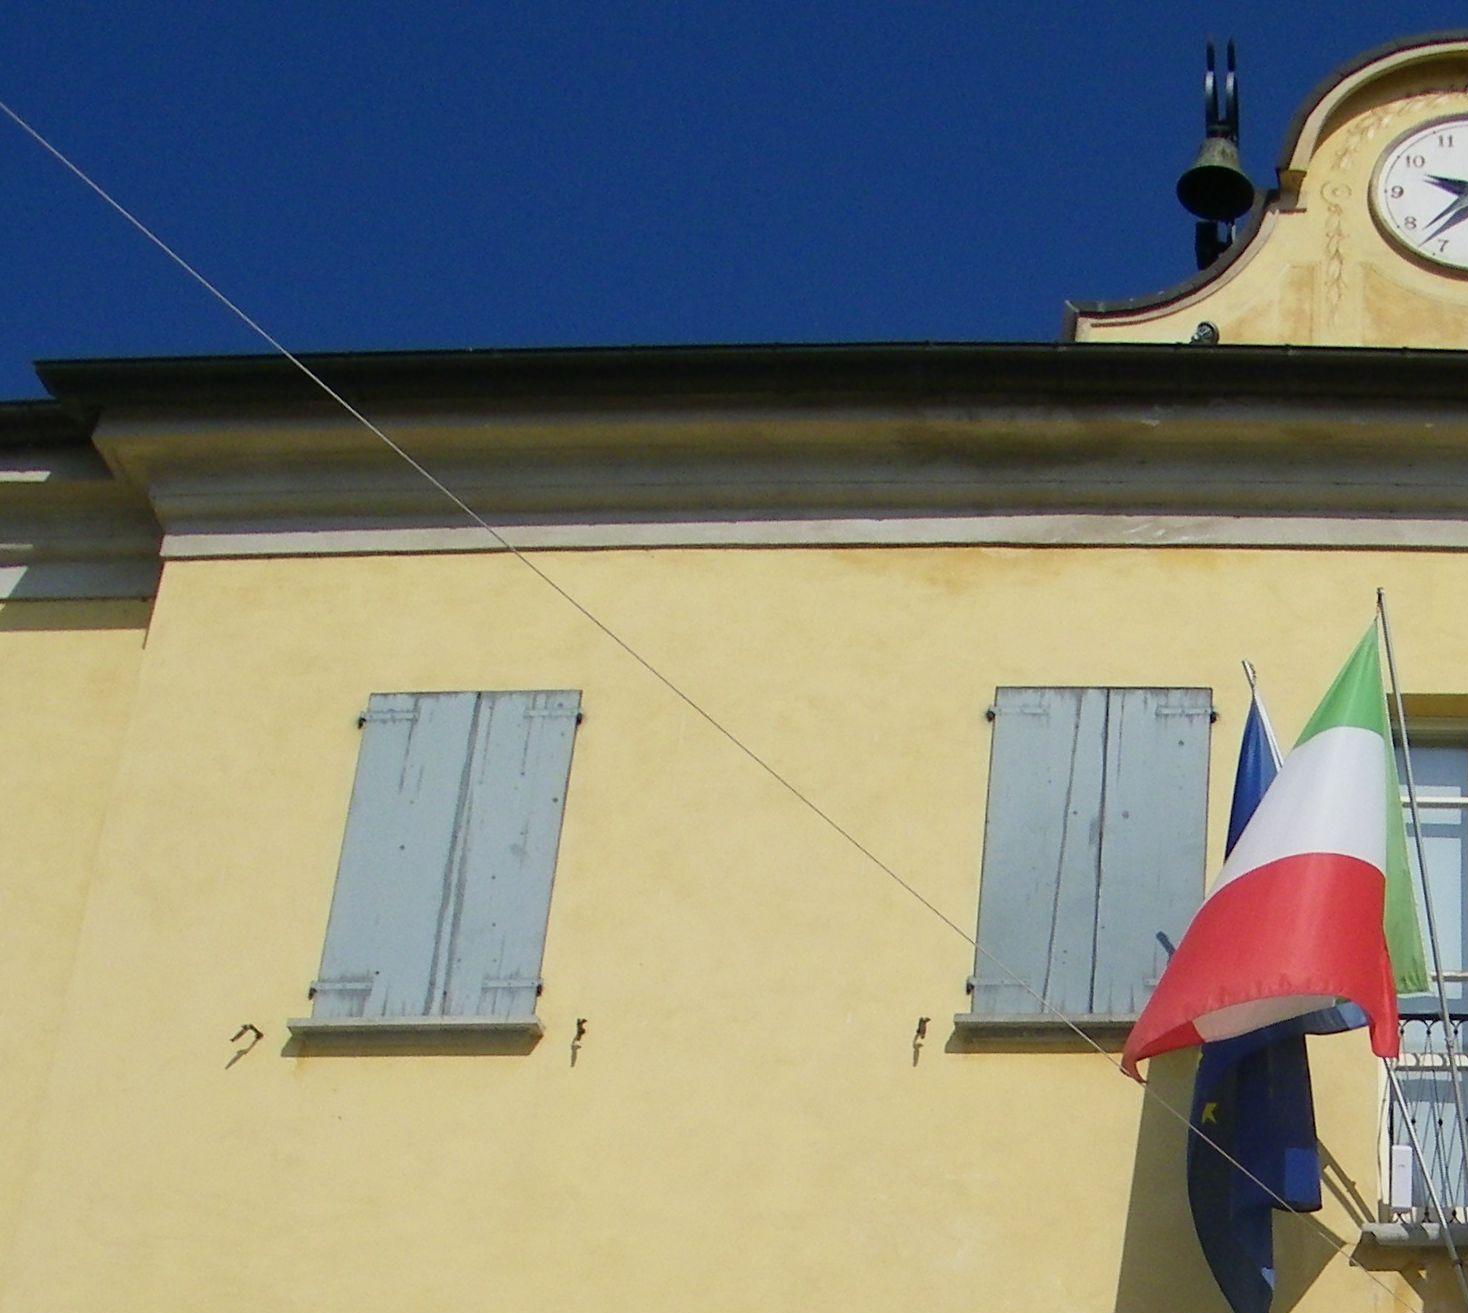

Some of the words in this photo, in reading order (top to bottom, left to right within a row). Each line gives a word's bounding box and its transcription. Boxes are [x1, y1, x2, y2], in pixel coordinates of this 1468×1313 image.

[1437, 135, 1454, 147] 11
[1405, 155, 1426, 168] 10
[1390, 185, 1404, 199] 9
[1404, 216, 1417, 230] 8
[1437, 239, 1449, 253] 7
